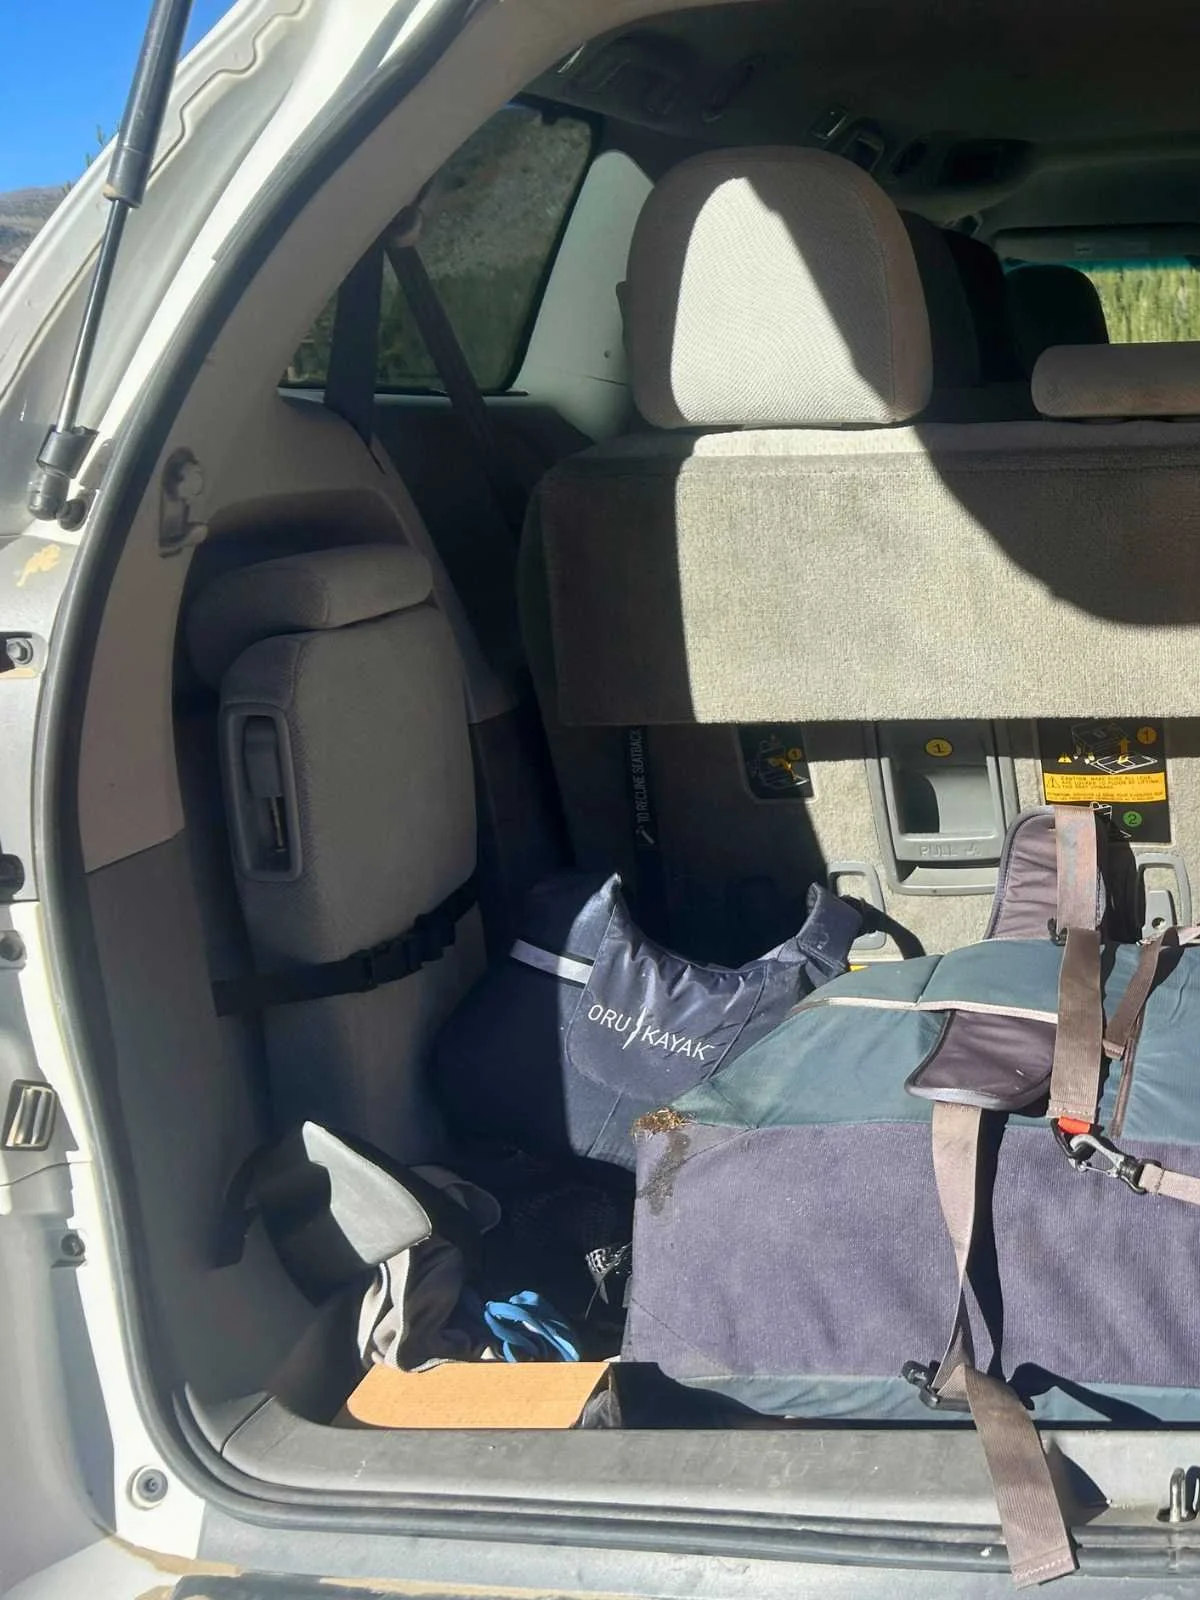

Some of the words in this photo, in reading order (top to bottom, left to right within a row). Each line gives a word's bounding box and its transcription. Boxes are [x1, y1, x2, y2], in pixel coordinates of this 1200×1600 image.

[632, 775, 648, 811] RECLINE
[636, 812, 649, 823] TO
[920, 844, 958, 857] PULL
[588, 1004, 632, 1032] ORU
[641, 1025, 712, 1060] KAYAK
